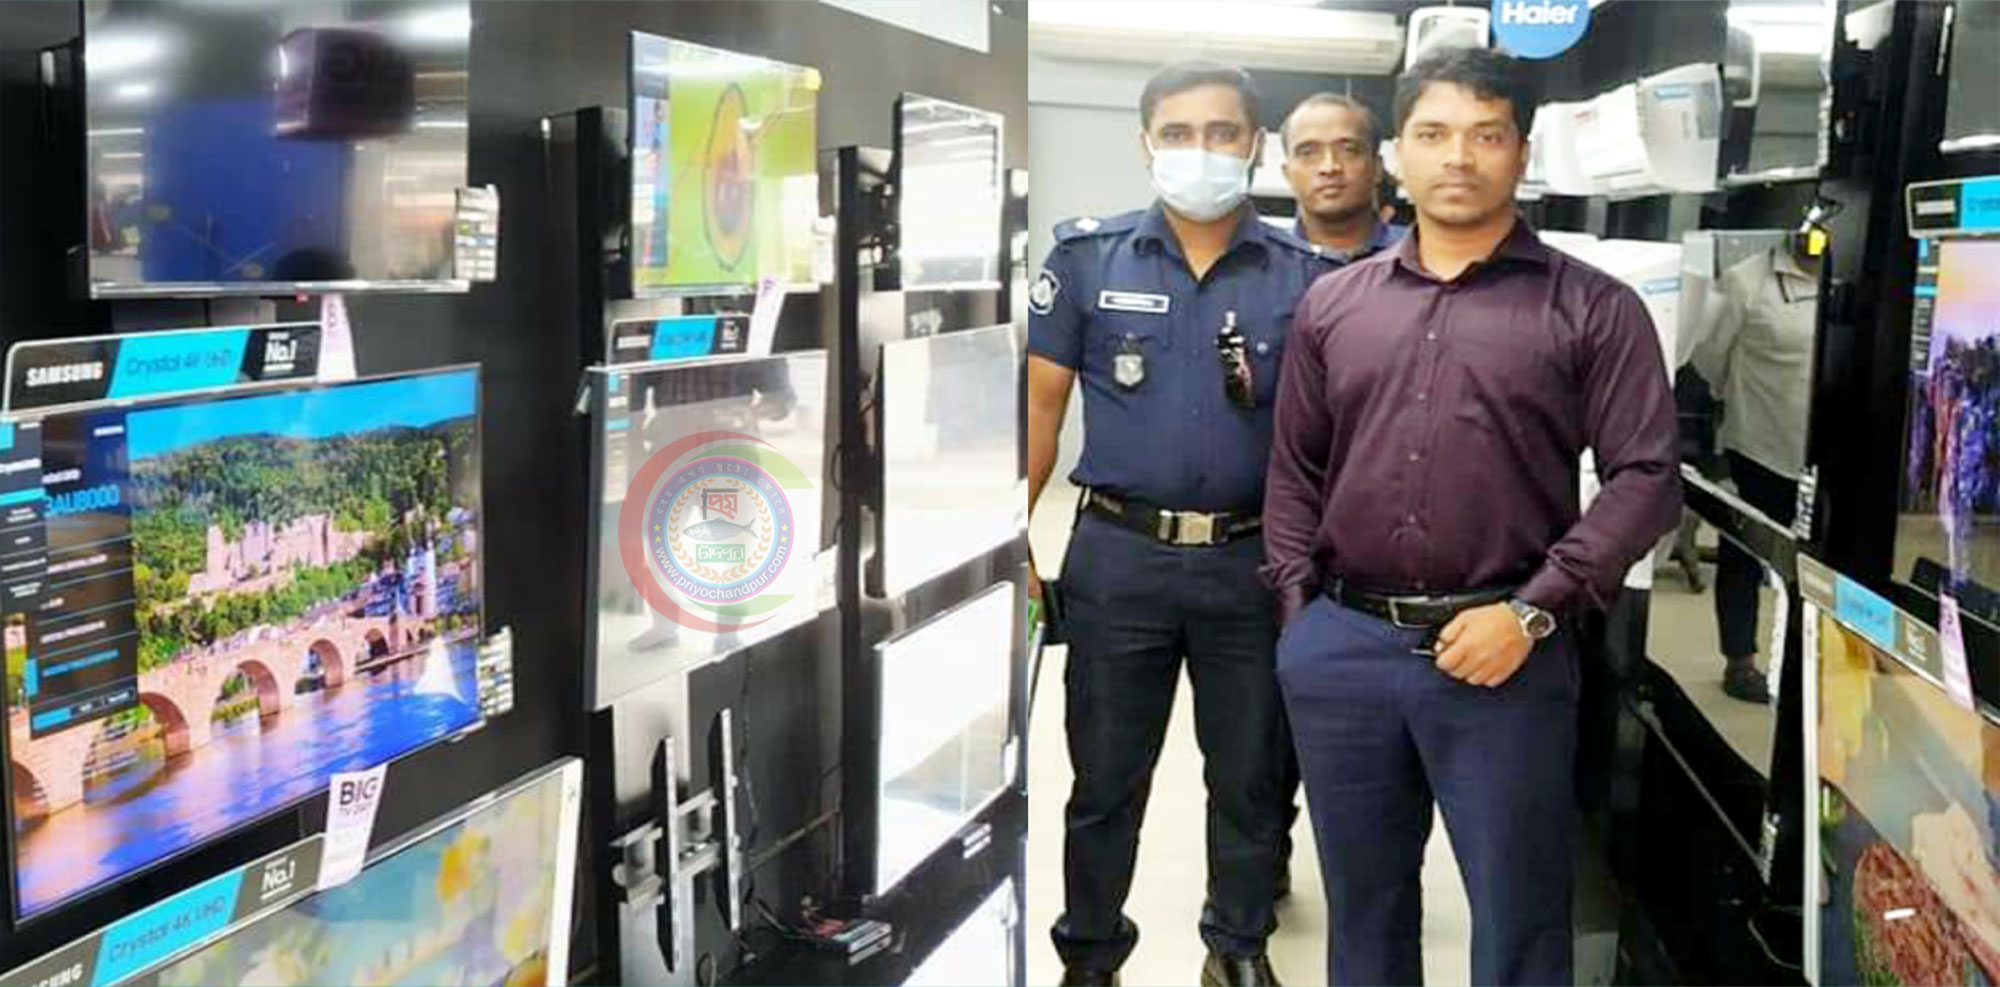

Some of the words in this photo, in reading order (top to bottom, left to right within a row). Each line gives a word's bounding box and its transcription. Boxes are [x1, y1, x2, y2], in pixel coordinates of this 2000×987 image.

[1501, 0, 1579, 24] Haier
[26, 361, 103, 387] SAMSUNG
[339, 776, 379, 805] BIG
